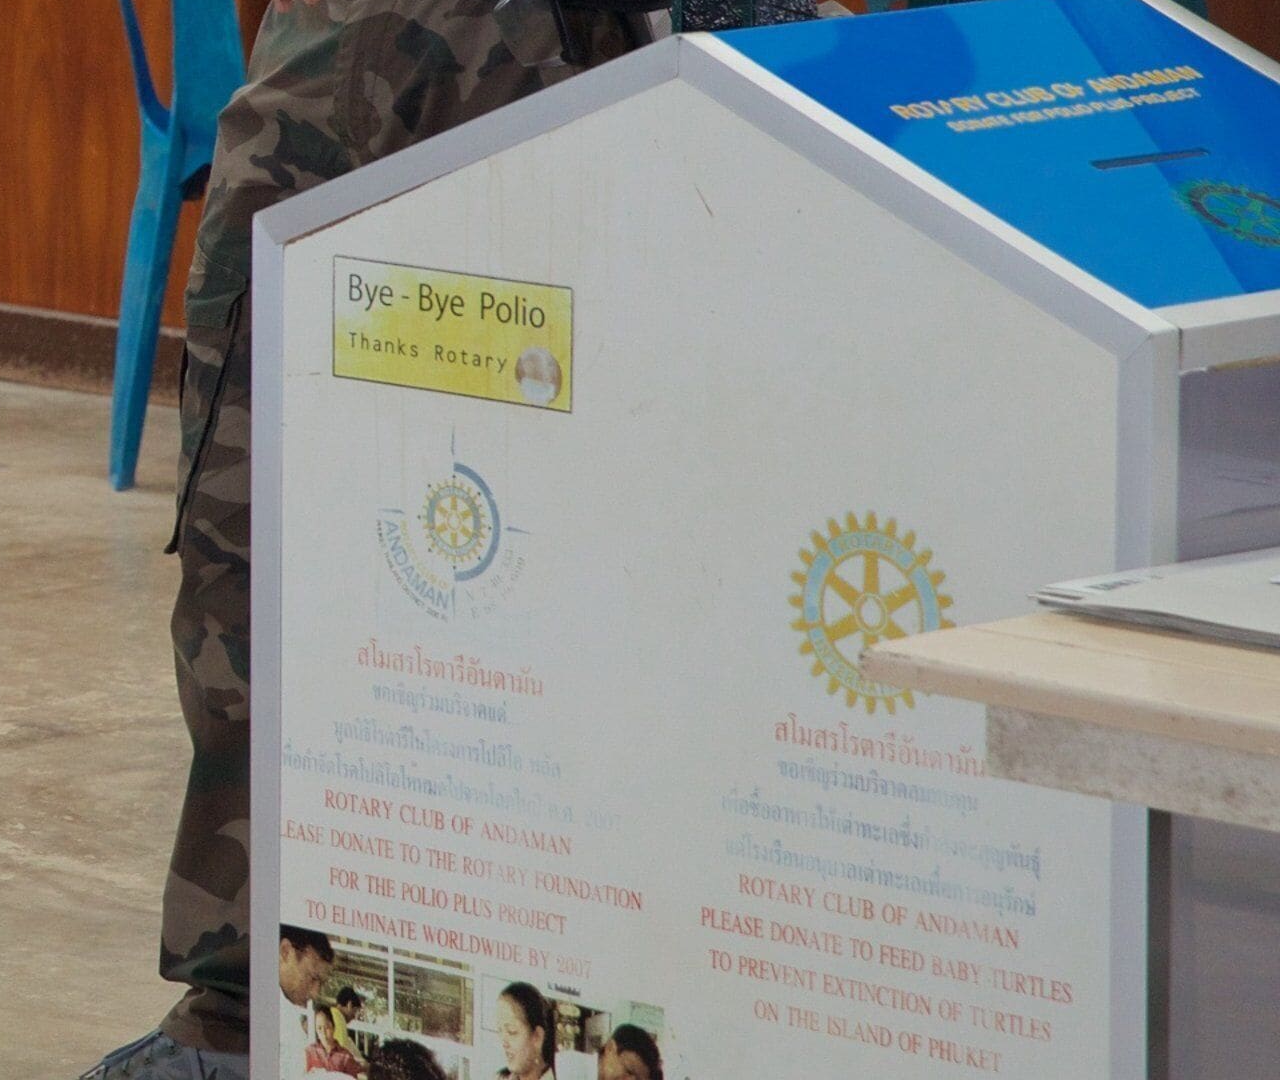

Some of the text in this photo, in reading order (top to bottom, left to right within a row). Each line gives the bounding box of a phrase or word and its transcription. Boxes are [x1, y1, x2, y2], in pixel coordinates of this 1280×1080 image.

[890, 65, 1205, 120] ROTARY CLUB OF ANDAMAN
[1130, 86, 1202, 107] PROJECT
[349, 273, 394, 311] Bye
[419, 283, 465, 321] Bye
[481, 291, 545, 328] Polio
[349, 332, 508, 373] Thanks Rotary
[383, 520, 450, 610] ANDAMAN
[325, 788, 572, 855] ROTARY CLUB OF ANDAMAN
[282, 818, 643, 911] EASE DONATE TO THE ROTARY FOUNDATION
[329, 867, 568, 935] FOR THE POLIO PLUS PROJECT
[306, 899, 592, 980] TO ELIMINATE WORLDWIDE BY 2007
[739, 873, 1019, 949] ROTARY CLUB OF ANDAMAN
[701, 905, 1073, 1005] PLEASE DONATE TO FEED BABY TURTLES
[708, 948, 1053, 1042] TO PREVENT EXTINCTION OF TURTLES
[753, 999, 1003, 1073] ON THE ISLAND OF PHUKET
